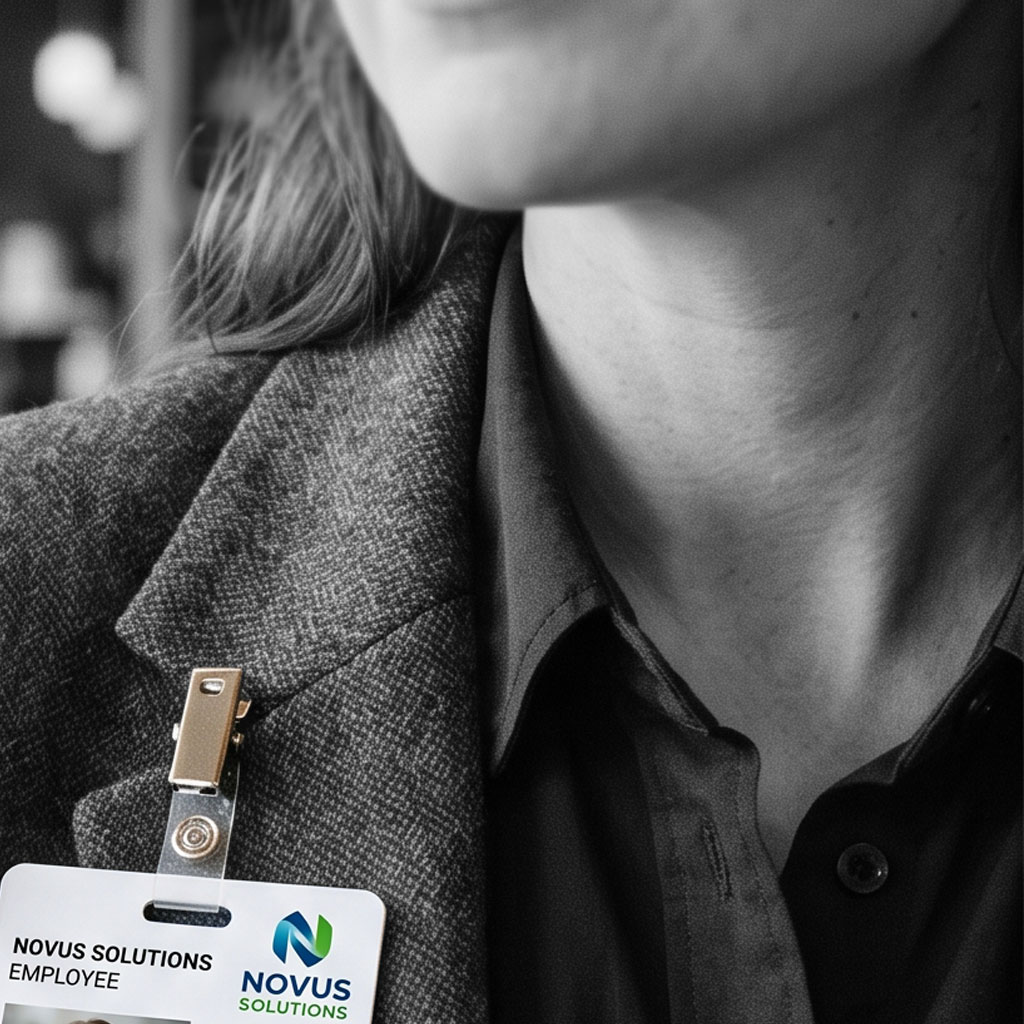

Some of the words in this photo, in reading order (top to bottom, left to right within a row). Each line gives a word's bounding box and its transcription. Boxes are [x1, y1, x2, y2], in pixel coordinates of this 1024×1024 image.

[12, 936, 86, 960] NOVUS
[90, 944, 213, 972] SOLUTIONS
[8, 962, 121, 990] EMPLOYEE
[241, 970, 351, 1002] NOVUS
[238, 997, 348, 1020] SOLUTIONS
